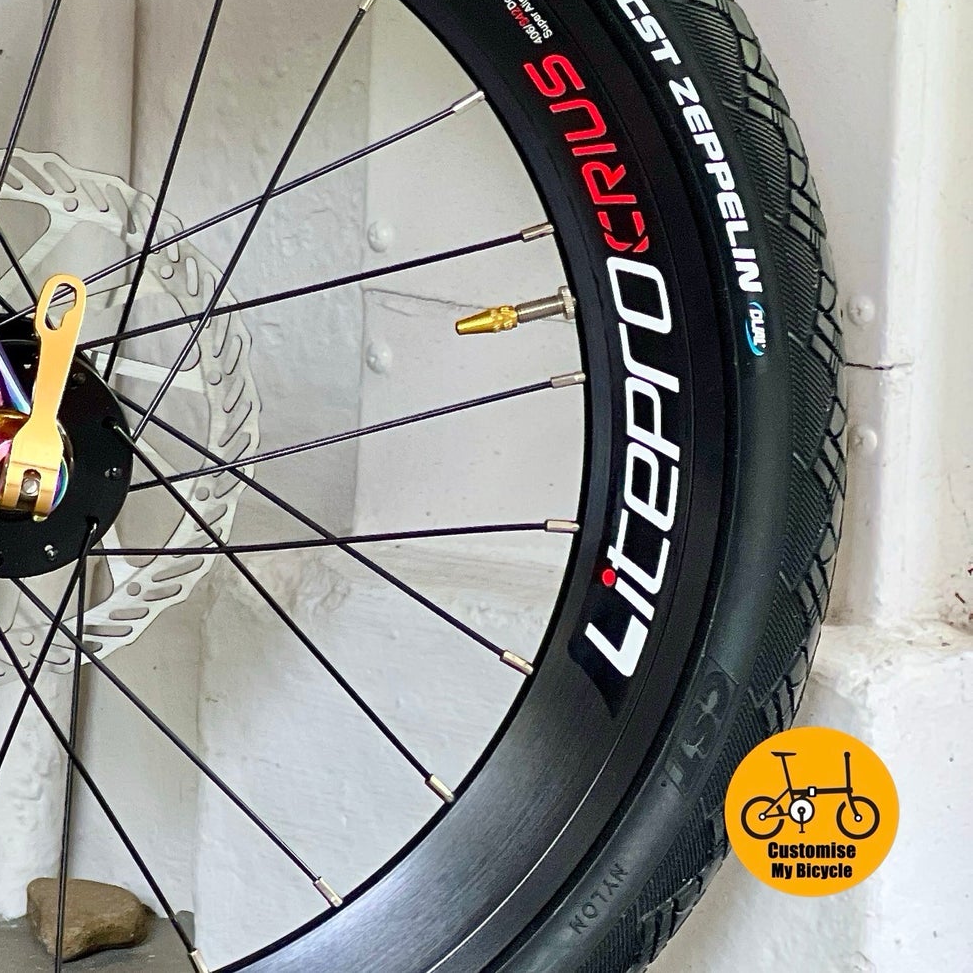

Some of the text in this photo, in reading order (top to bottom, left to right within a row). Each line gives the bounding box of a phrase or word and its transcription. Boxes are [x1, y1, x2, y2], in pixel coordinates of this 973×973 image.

[530, 11, 553, 39] Super
[523, 53, 649, 253] CRIUS
[668, 76, 765, 294] ZEPPELIN
[568, 862, 628, 936] NYLON
